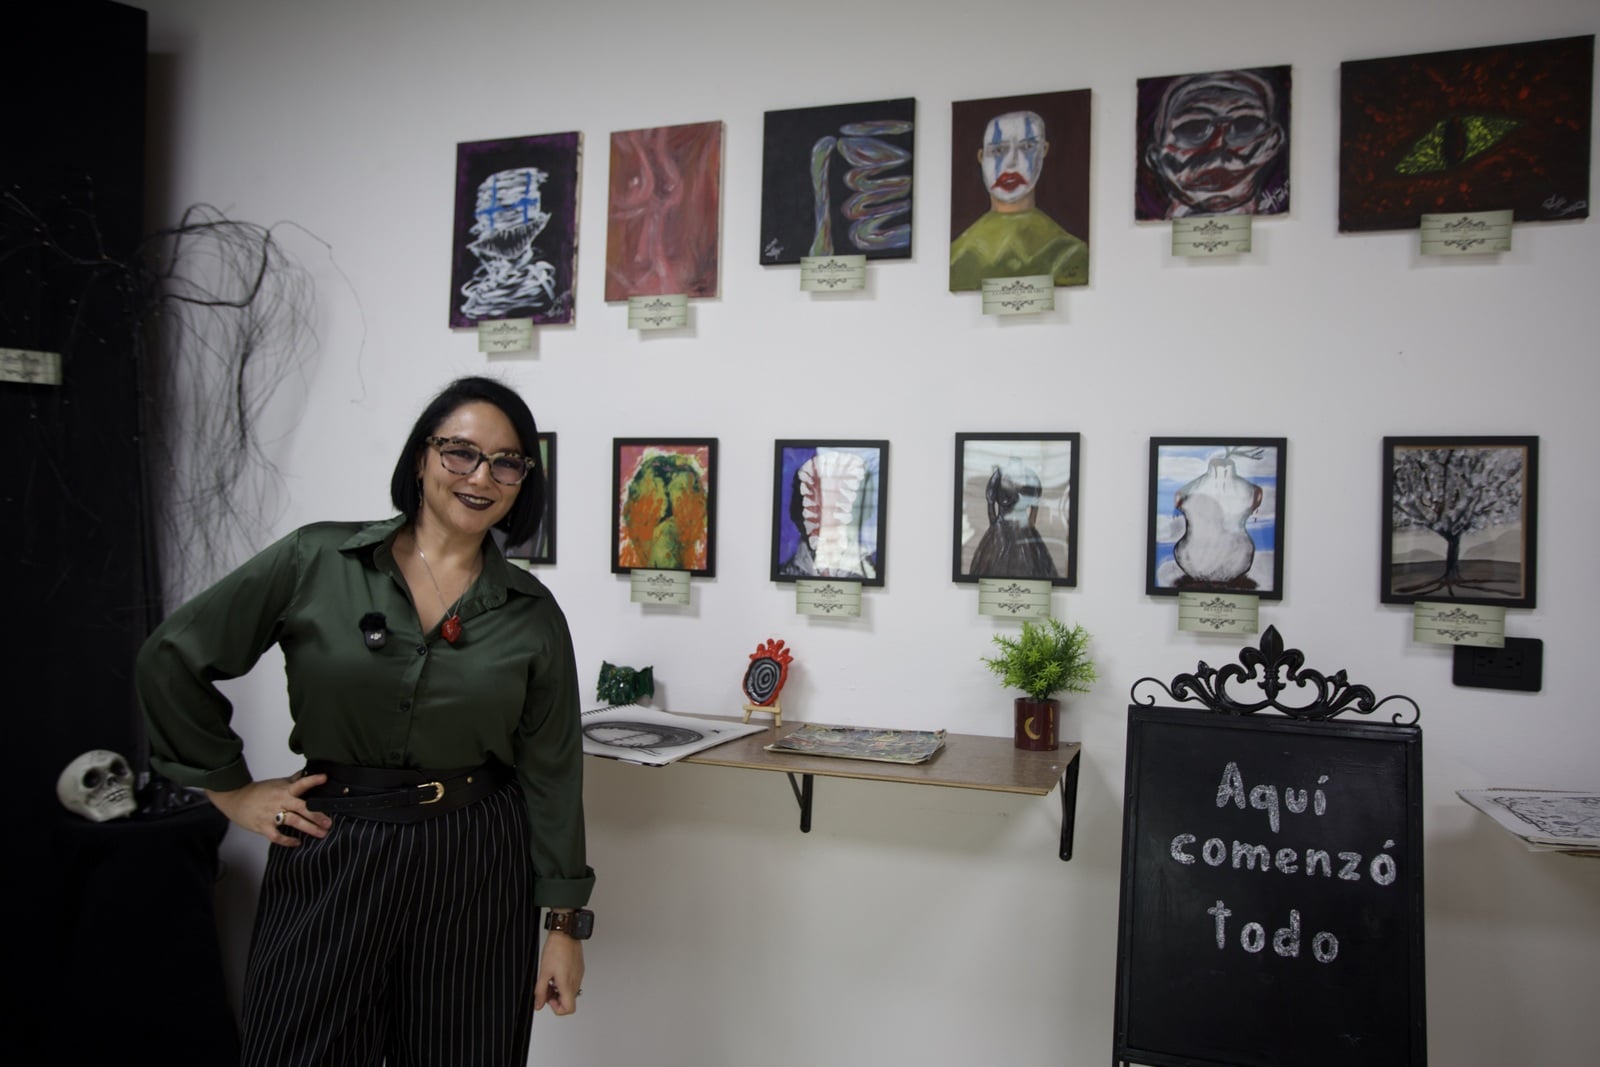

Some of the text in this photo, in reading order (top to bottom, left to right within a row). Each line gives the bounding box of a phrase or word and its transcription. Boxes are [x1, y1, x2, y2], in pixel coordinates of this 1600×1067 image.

[1216, 761, 1329, 833] Aquí
[1170, 833, 1397, 886] comenzó
[1207, 900, 1339, 963] todo
